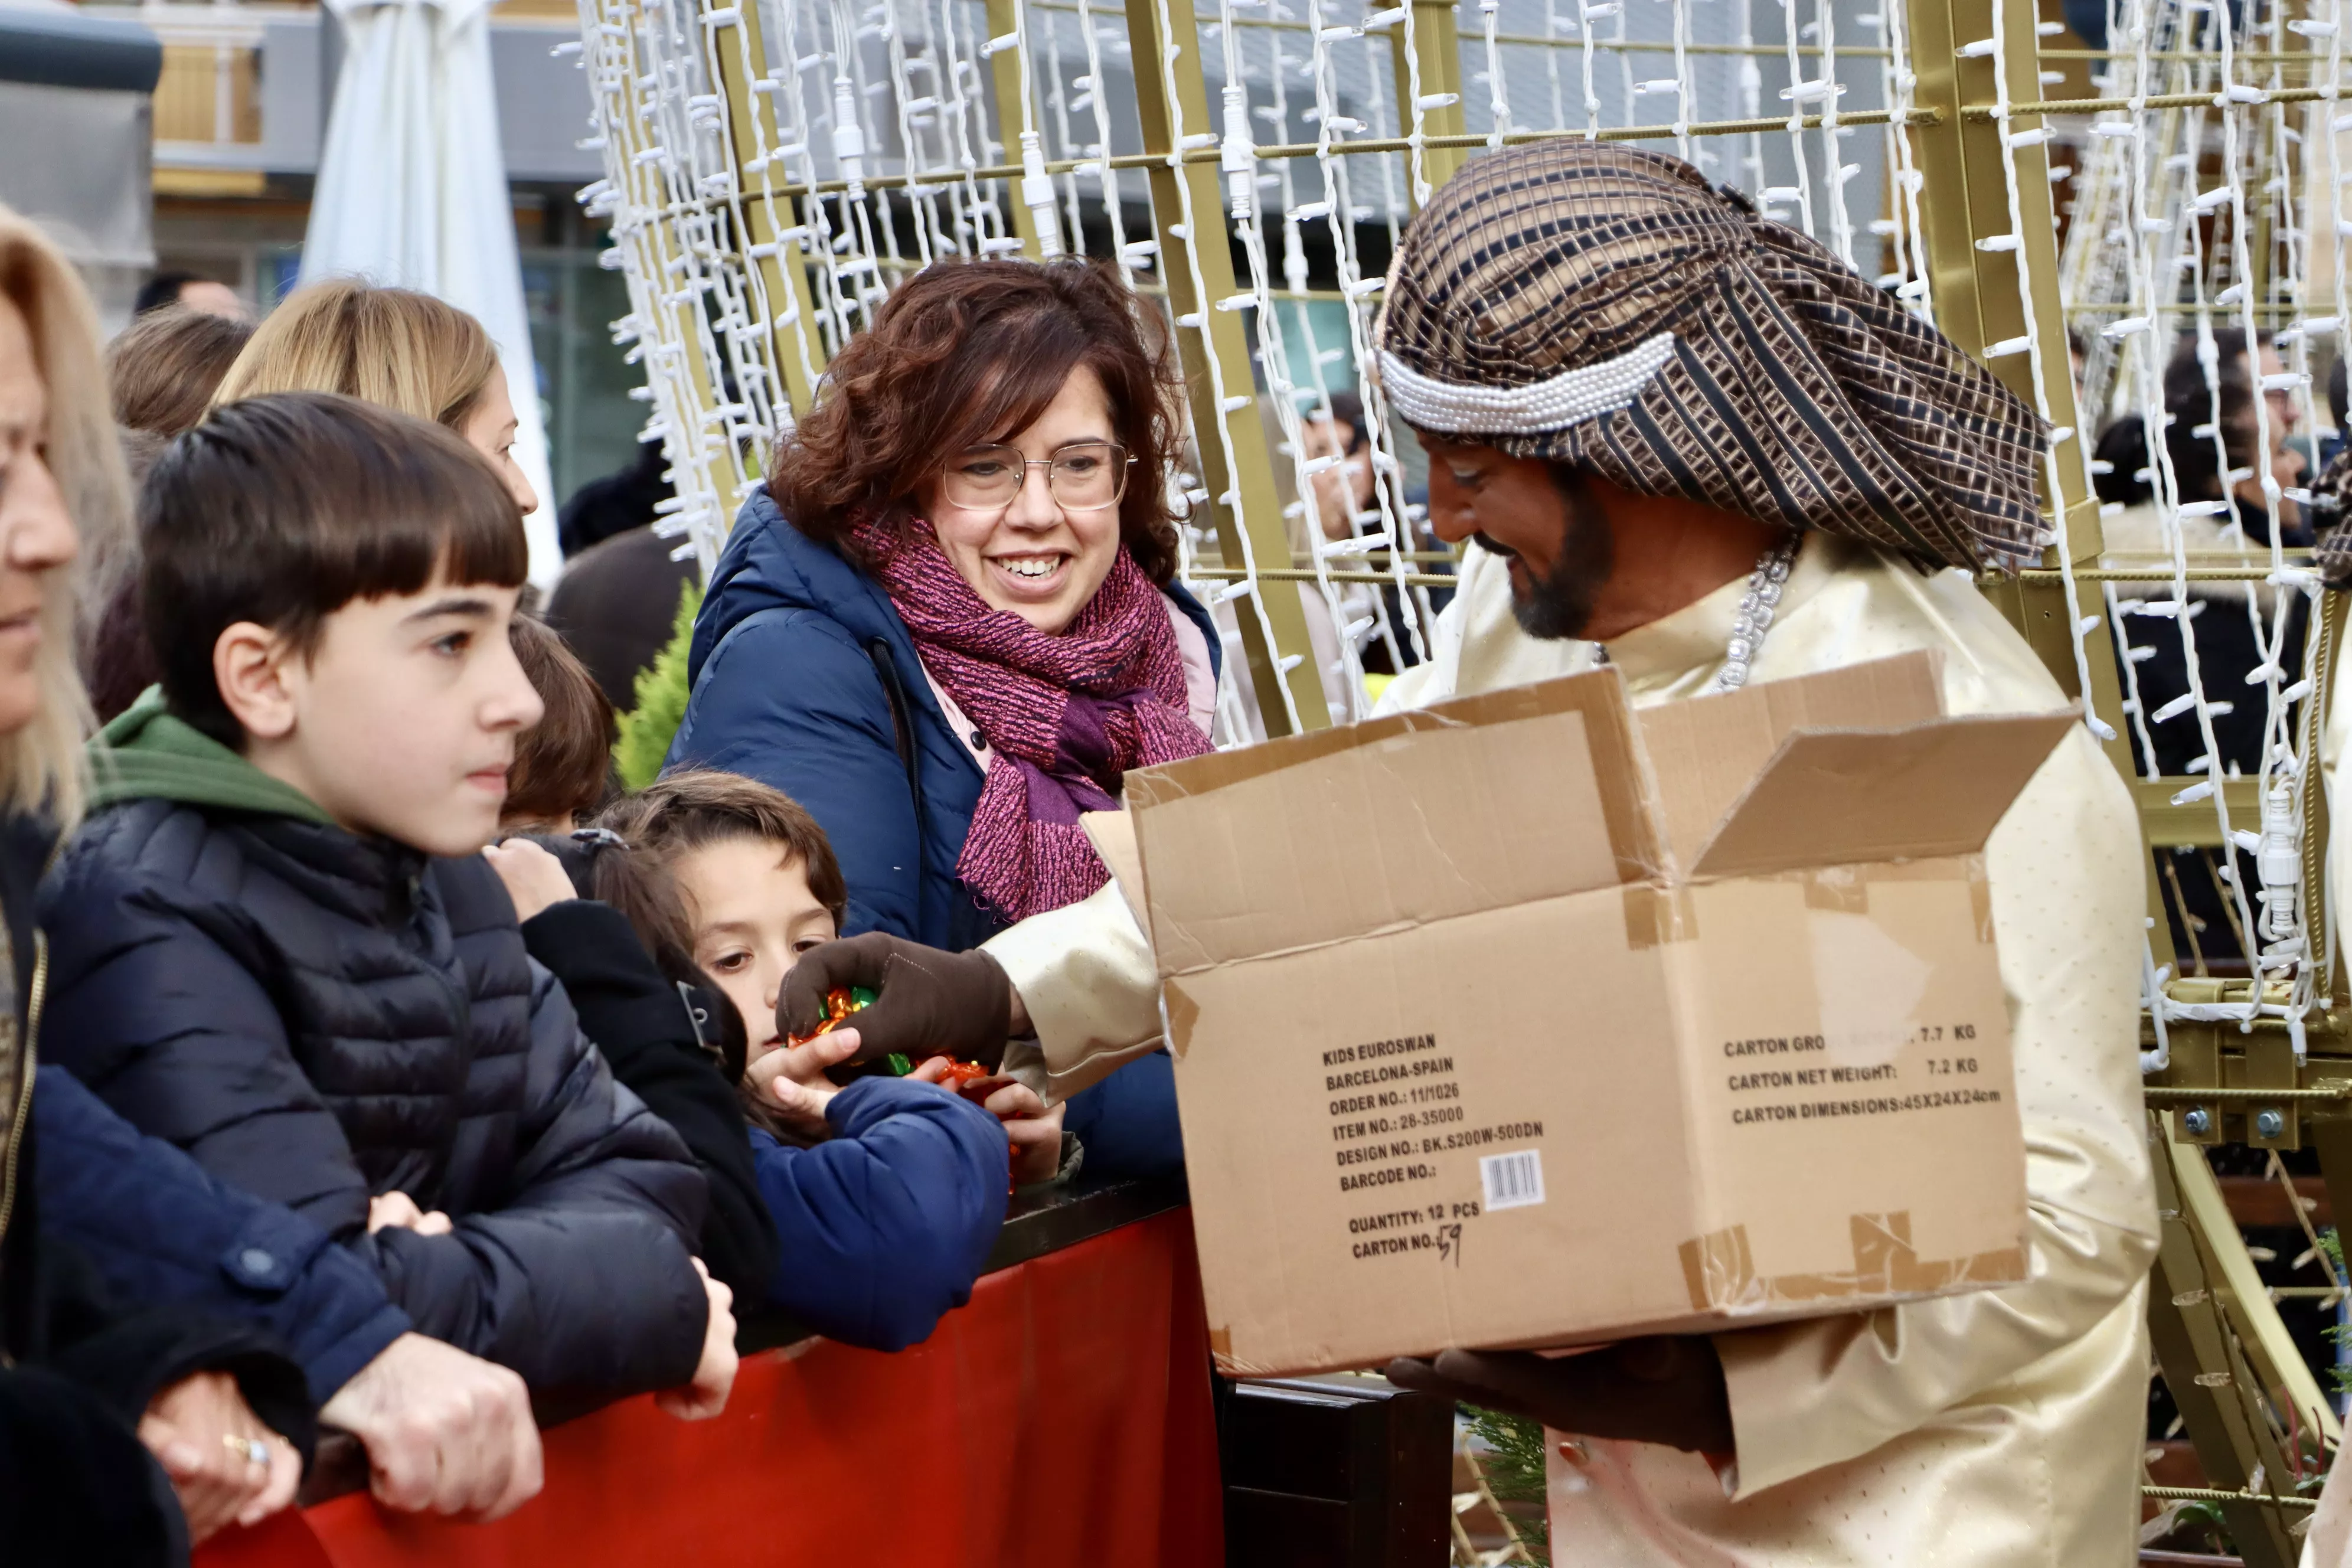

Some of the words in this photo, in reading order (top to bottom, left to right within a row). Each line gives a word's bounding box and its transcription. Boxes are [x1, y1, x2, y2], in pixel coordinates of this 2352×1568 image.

[1323, 1046, 1355, 1066] KIDS
[1358, 1033, 1436, 1059] EUROSWAN
[1724, 1038, 1789, 1057] CARTON
[1793, 1034, 1825, 1051] GRO
[1921, 1027, 1943, 1041] 7.7
[1955, 1025, 1976, 1039] KG
[1327, 1057, 1453, 1090] BARCELONA-SPAIN
[1729, 1072, 1792, 1090] CARTON
[1797, 1069, 1826, 1084] NET
[1832, 1064, 1897, 1082] WEIGHT:
[1928, 1059, 1950, 1074] 7.2
[1956, 1059, 1978, 1073] KG
[1330, 1095, 1376, 1115] ORDER
[1378, 1090, 1407, 1106] NO.:
[1410, 1083, 1459, 1104] 11/1026
[1733, 1105, 1797, 1124] CARTON
[1333, 1121, 1366, 1141] ITEM
[1370, 1119, 1397, 1134] NO.:
[1400, 1106, 1464, 1130] 28-35000
[1337, 1144, 1387, 1166] DESIGN
[1391, 1141, 1419, 1157] NO.:
[1341, 1167, 1404, 1192] BARCODE
[1407, 1165, 1436, 1178] NO.:
[1350, 1211, 1423, 1233] QUANTITY:
[1428, 1204, 1444, 1220] 12
[1453, 1202, 1479, 1219] PCS
[1353, 1237, 1409, 1259] CARTON
[1412, 1233, 1439, 1248] NO.:
